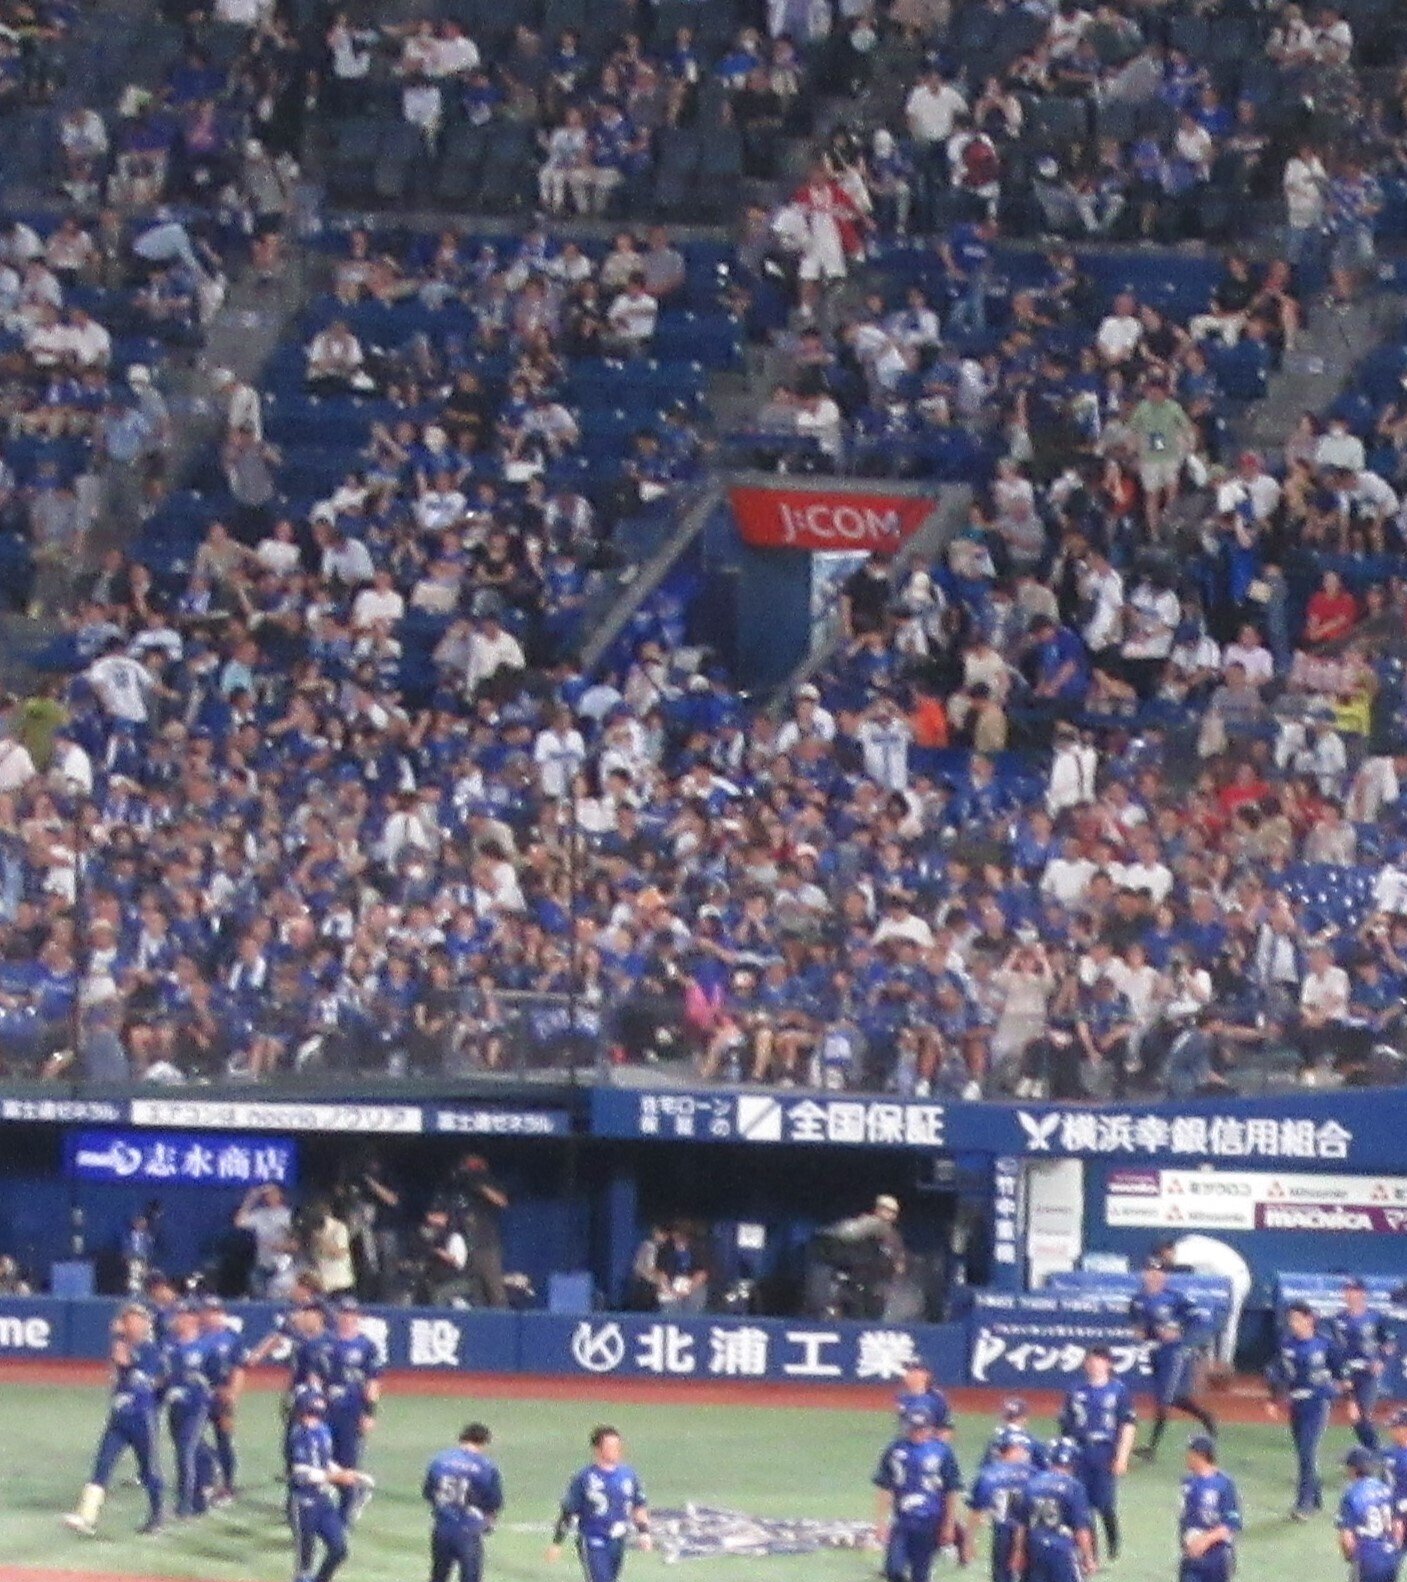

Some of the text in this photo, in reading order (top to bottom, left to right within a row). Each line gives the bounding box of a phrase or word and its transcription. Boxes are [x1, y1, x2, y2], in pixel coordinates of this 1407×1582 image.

[787, 1099, 945, 1146] 全国保証
[1060, 1112, 1353, 1159] 横浜幸銀信用組合
[636, 1325, 921, 1379] 北浦工業
